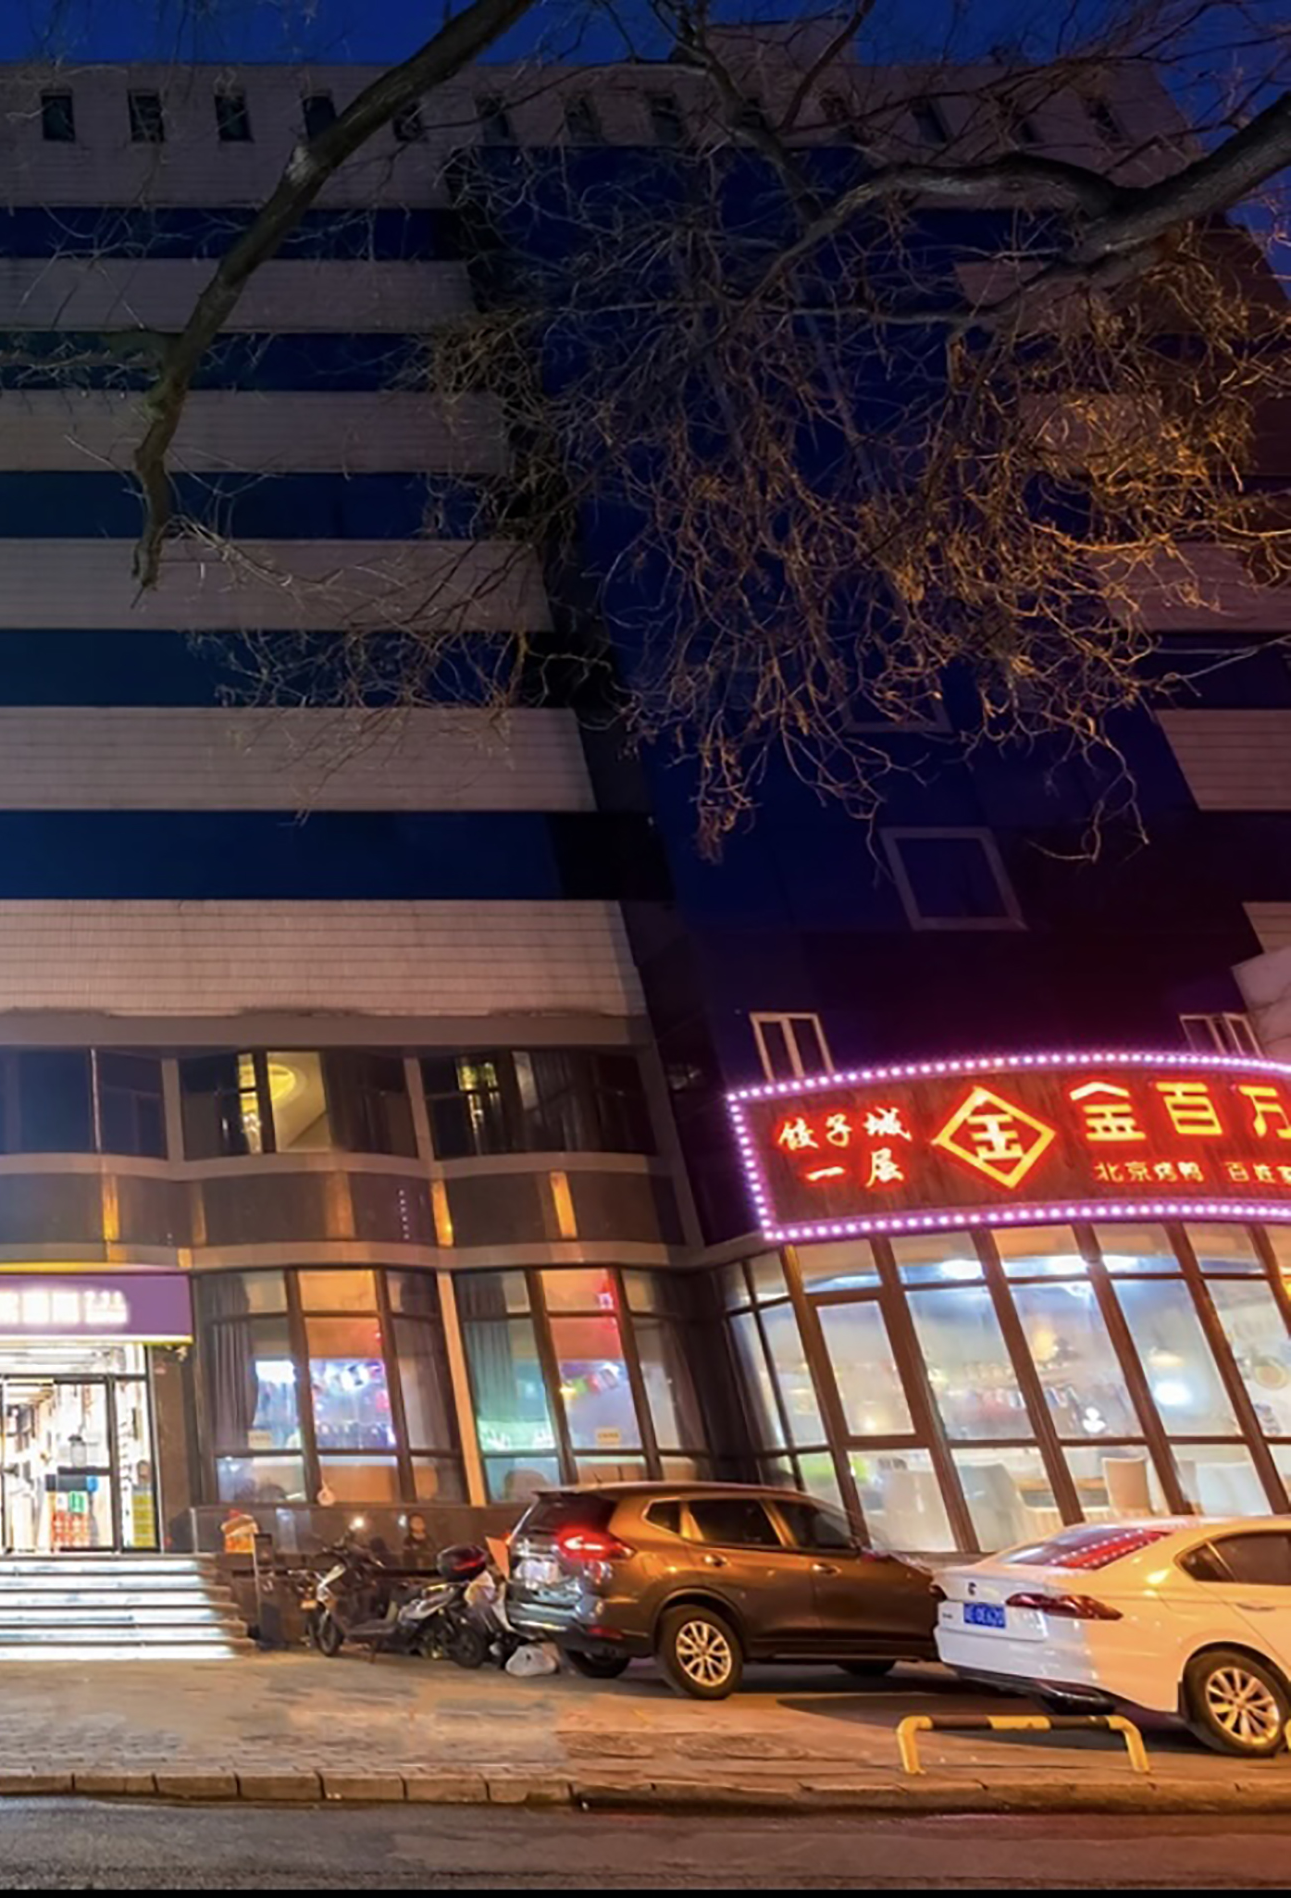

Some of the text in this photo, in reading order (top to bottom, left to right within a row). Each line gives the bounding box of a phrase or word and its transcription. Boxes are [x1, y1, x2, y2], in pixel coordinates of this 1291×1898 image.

[1070, 1081, 1291, 1141] 金百万
[1094, 1161, 1204, 1183] 北京烤鸭
